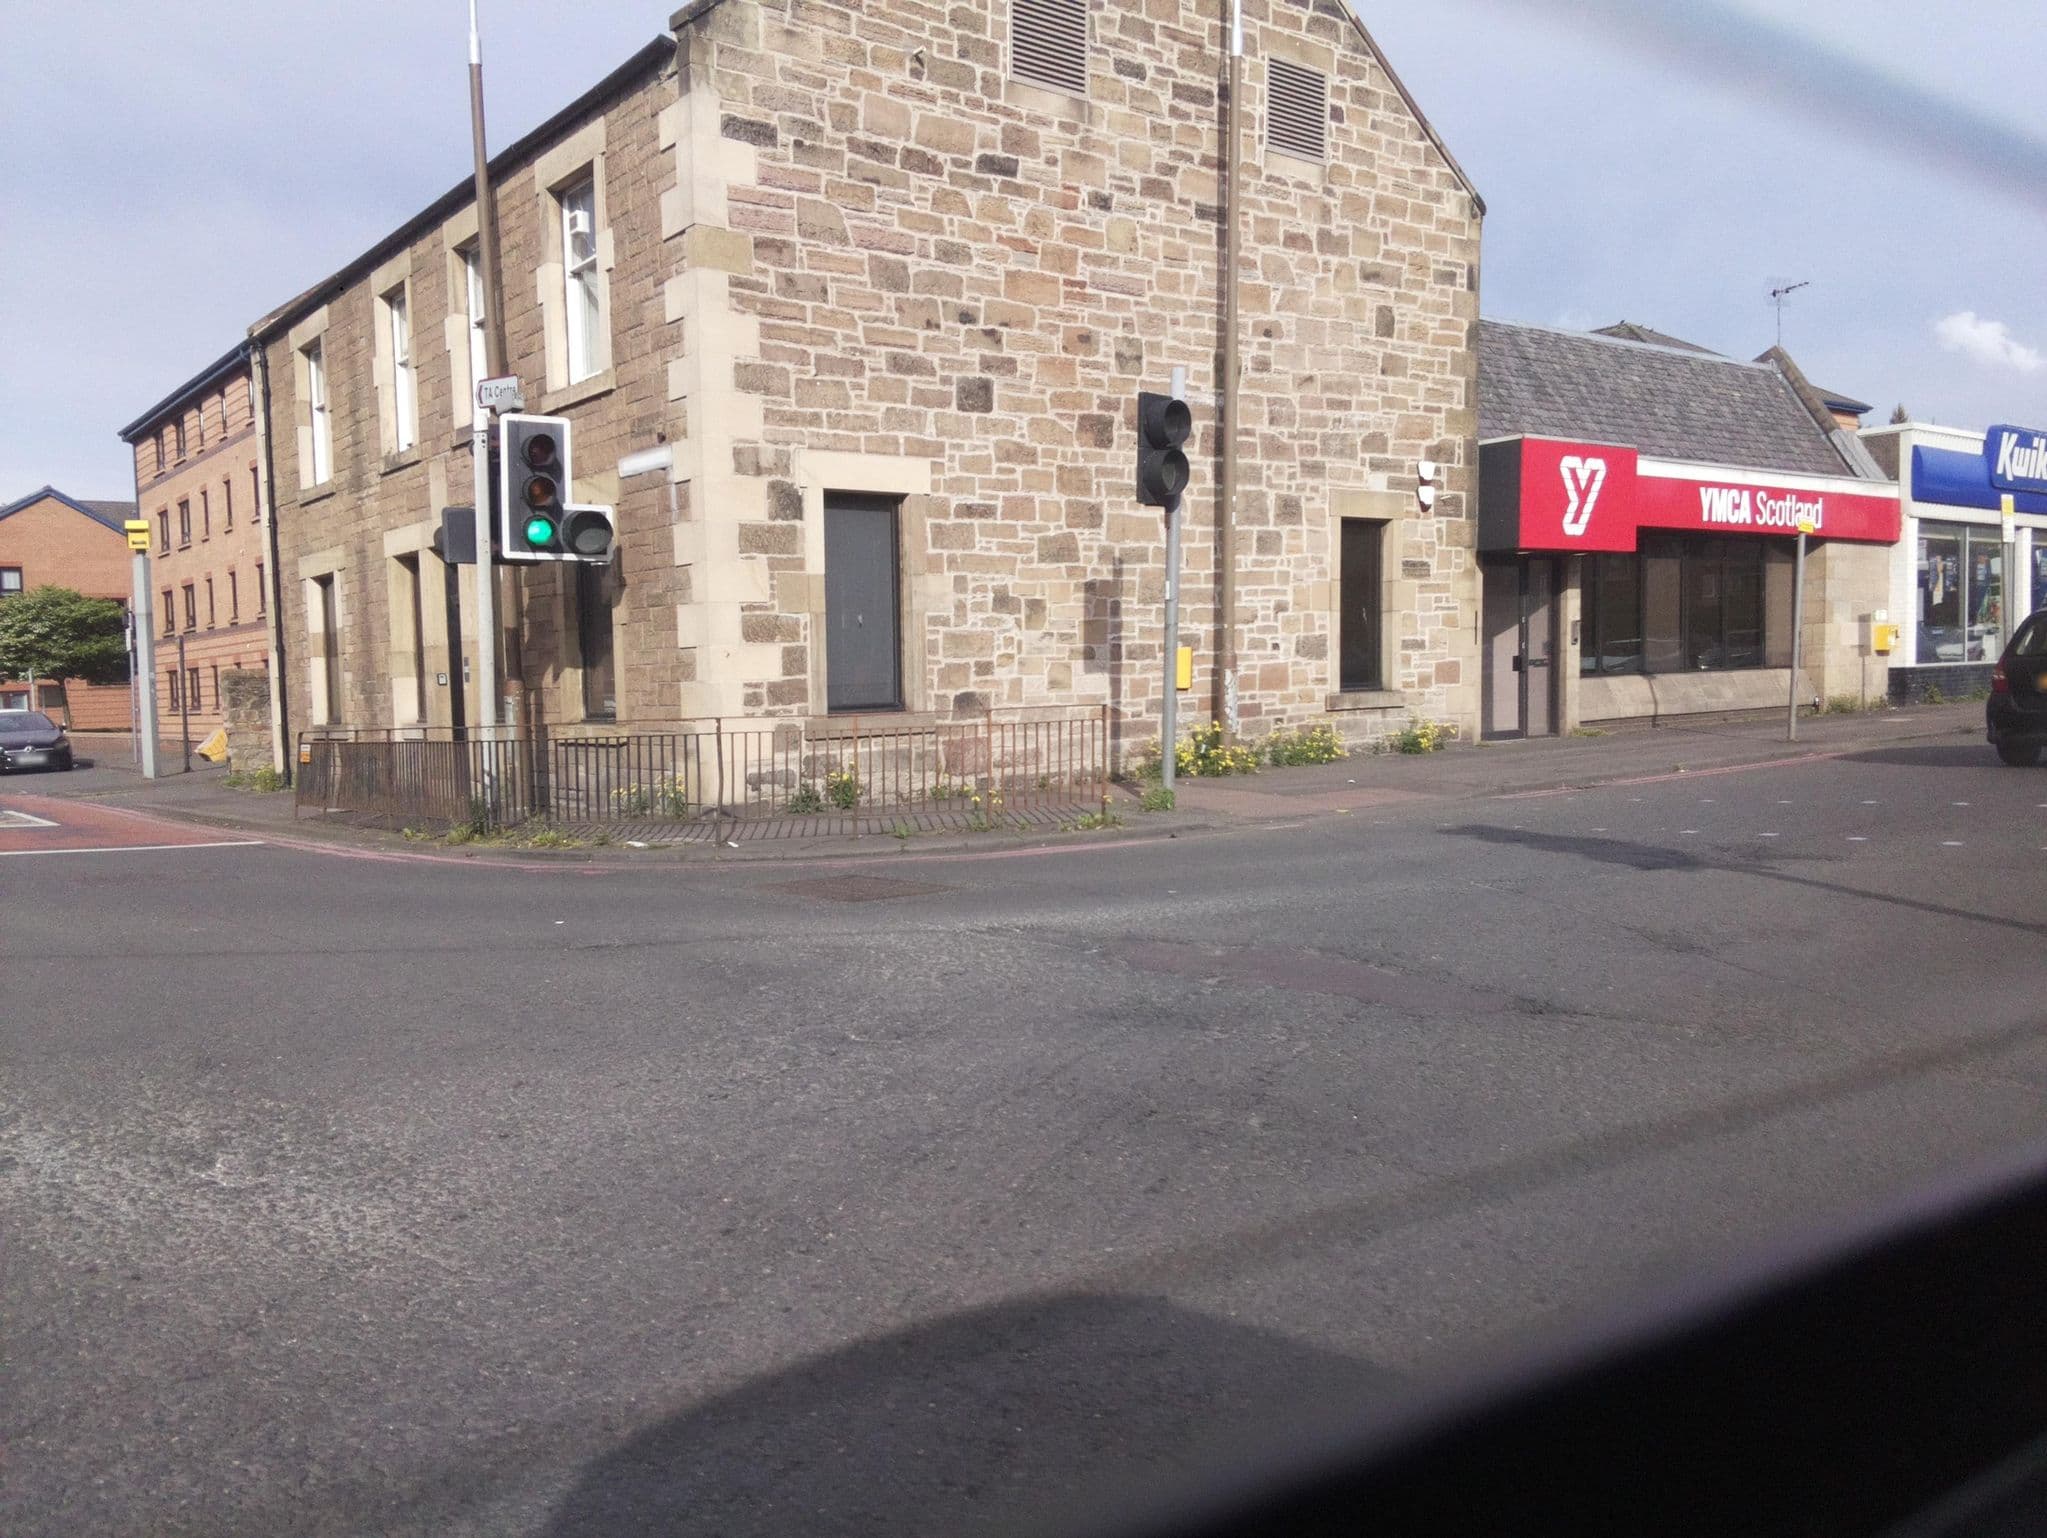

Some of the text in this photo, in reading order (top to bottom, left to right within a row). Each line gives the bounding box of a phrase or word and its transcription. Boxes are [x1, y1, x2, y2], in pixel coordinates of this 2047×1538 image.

[1996, 431, 2047, 481] Kwik
[1699, 486, 1823, 529] YMCA Scotland
